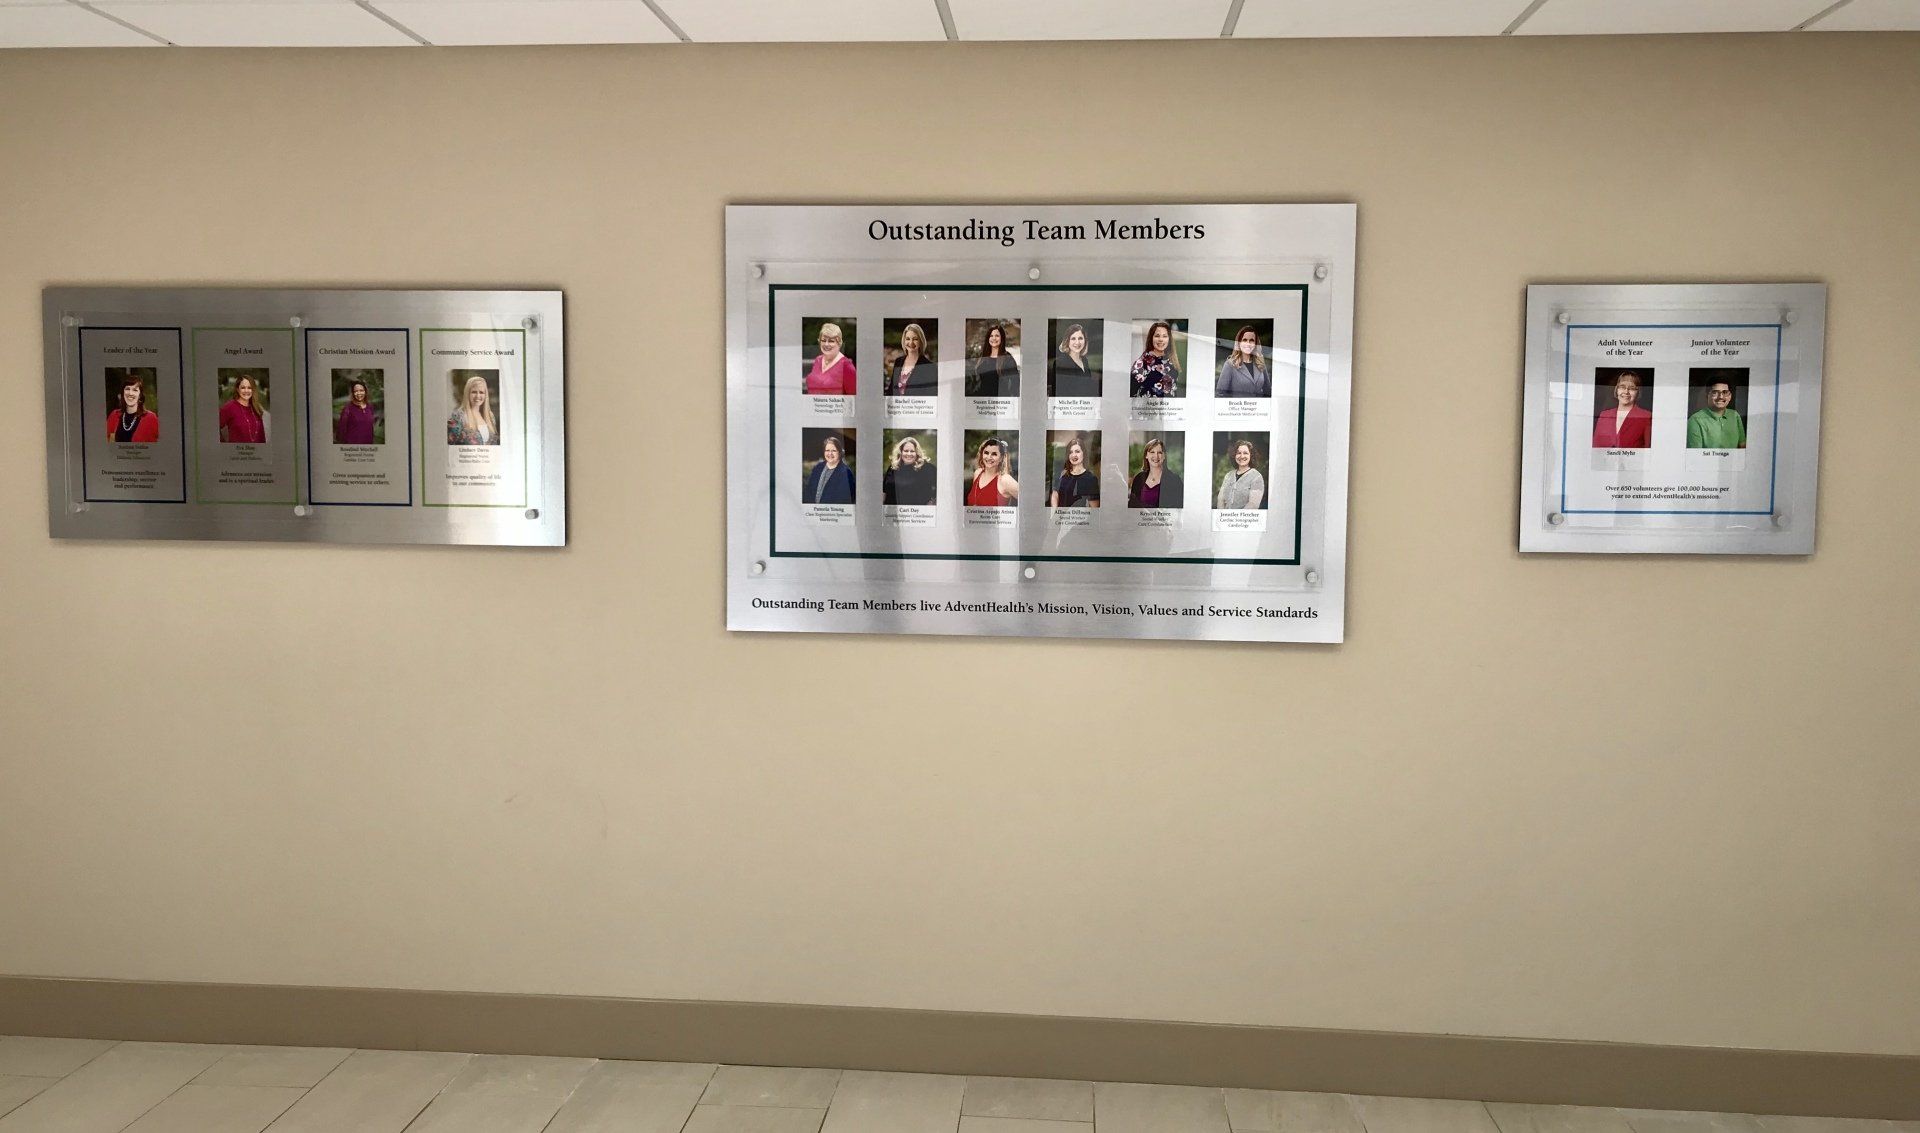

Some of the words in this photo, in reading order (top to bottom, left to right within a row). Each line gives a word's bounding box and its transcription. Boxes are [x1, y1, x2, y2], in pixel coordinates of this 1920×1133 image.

[868, 219, 1015, 246] Outstanding
[1022, 219, 1086, 240] Team
[1094, 218, 1205, 240] Members
[1690, 339, 1713, 347] Junior
[224, 347, 242, 356] Angel
[431, 348, 468, 357] Community
[752, 598, 824, 612] Outstanding
[828, 599, 859, 610] Team
[863, 600, 917, 612] Members
[920, 600, 942, 612] live
[944, 600, 1034, 614] AdventHealth's
[1038, 602, 1088, 616] Mission,
[1092, 603, 1134, 616] Vision,
[1138, 604, 1178, 616] Values
[1182, 604, 1204, 617] and
[1208, 605, 1252, 618] Service
[1256, 606, 1318, 619] Standards
